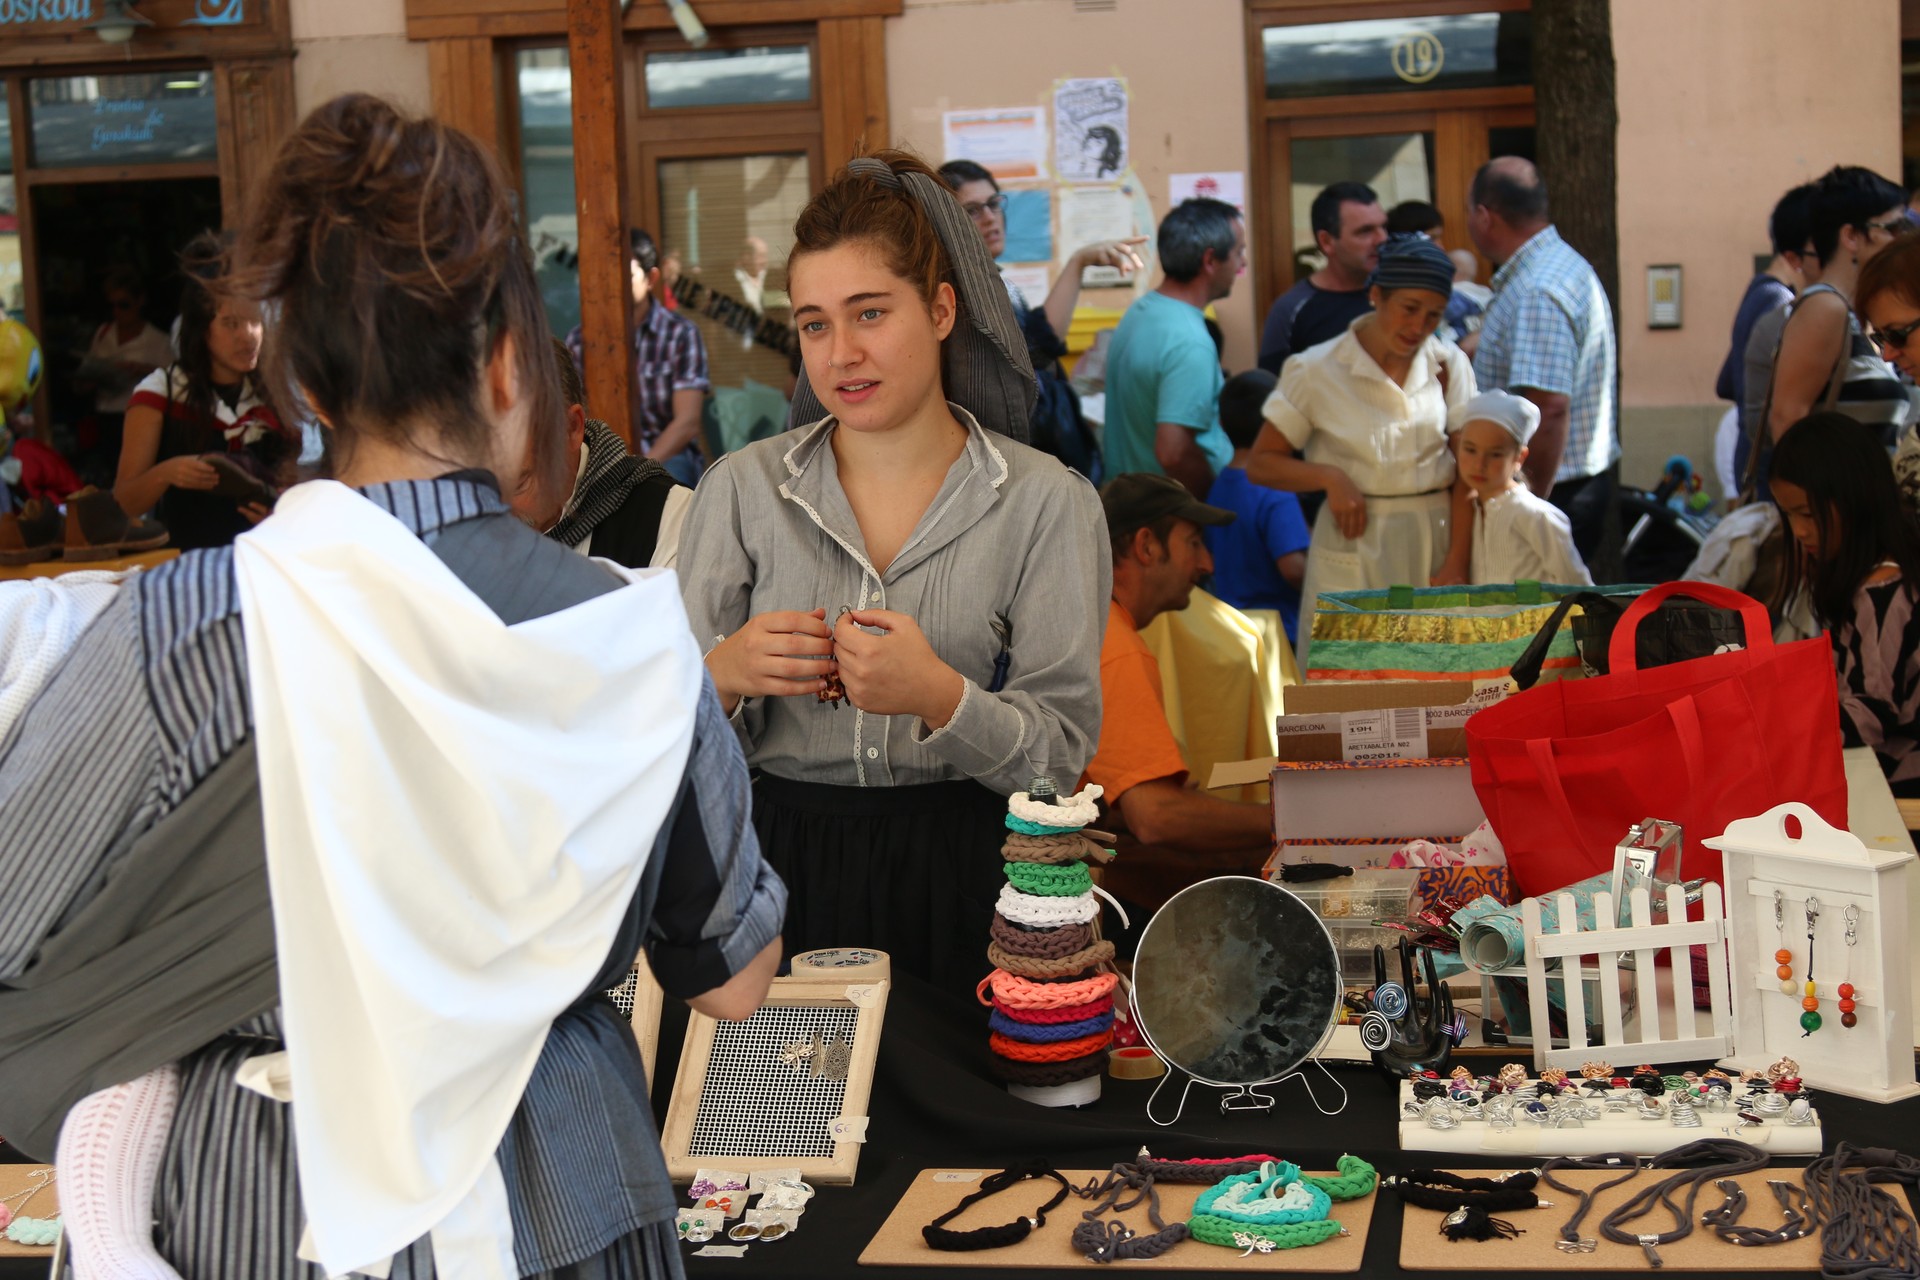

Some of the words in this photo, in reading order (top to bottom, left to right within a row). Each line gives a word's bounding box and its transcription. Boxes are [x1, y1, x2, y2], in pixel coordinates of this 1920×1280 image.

[1405, 38, 1433, 74] 19
[1278, 724, 1326, 733] BARCELONA
[1348, 742, 1395, 751] ARETXABALETA
[1354, 752, 1401, 760] 002015
